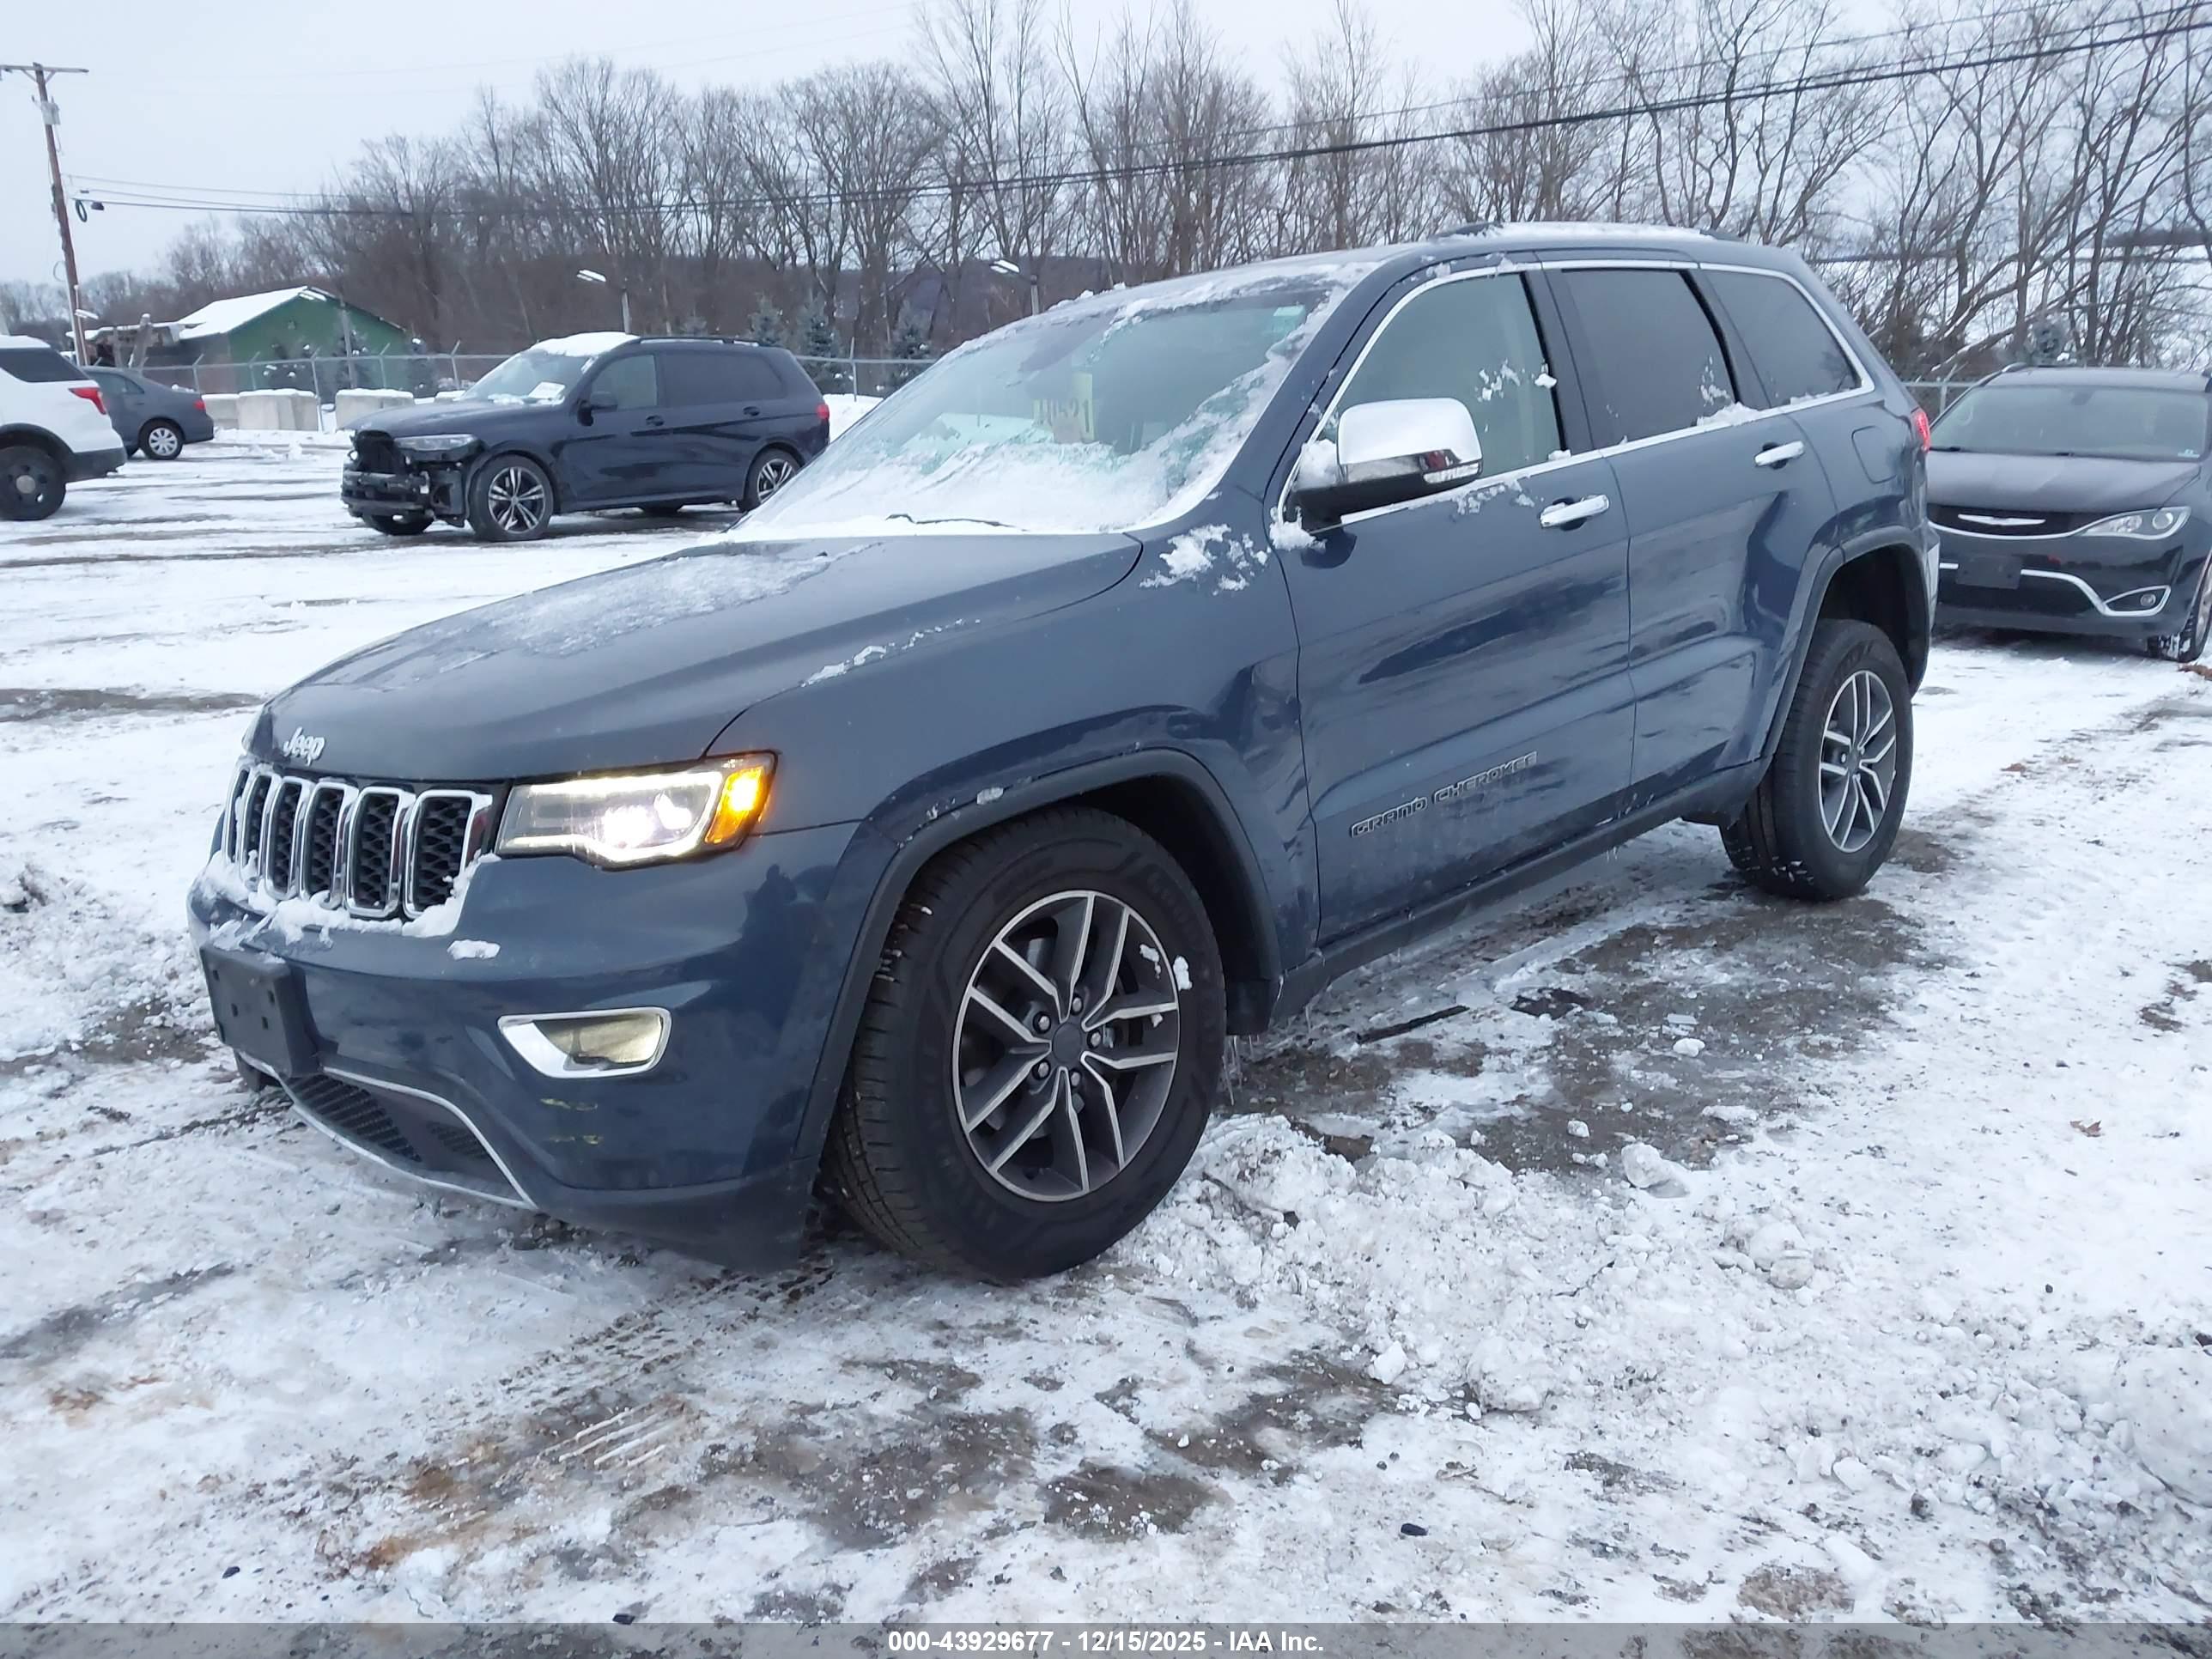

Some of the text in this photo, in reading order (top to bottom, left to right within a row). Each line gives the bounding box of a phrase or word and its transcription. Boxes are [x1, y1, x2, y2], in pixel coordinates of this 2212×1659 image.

[283, 726, 325, 767] Jeep
[1351, 750, 1538, 838] GRAND CHEROKEE
